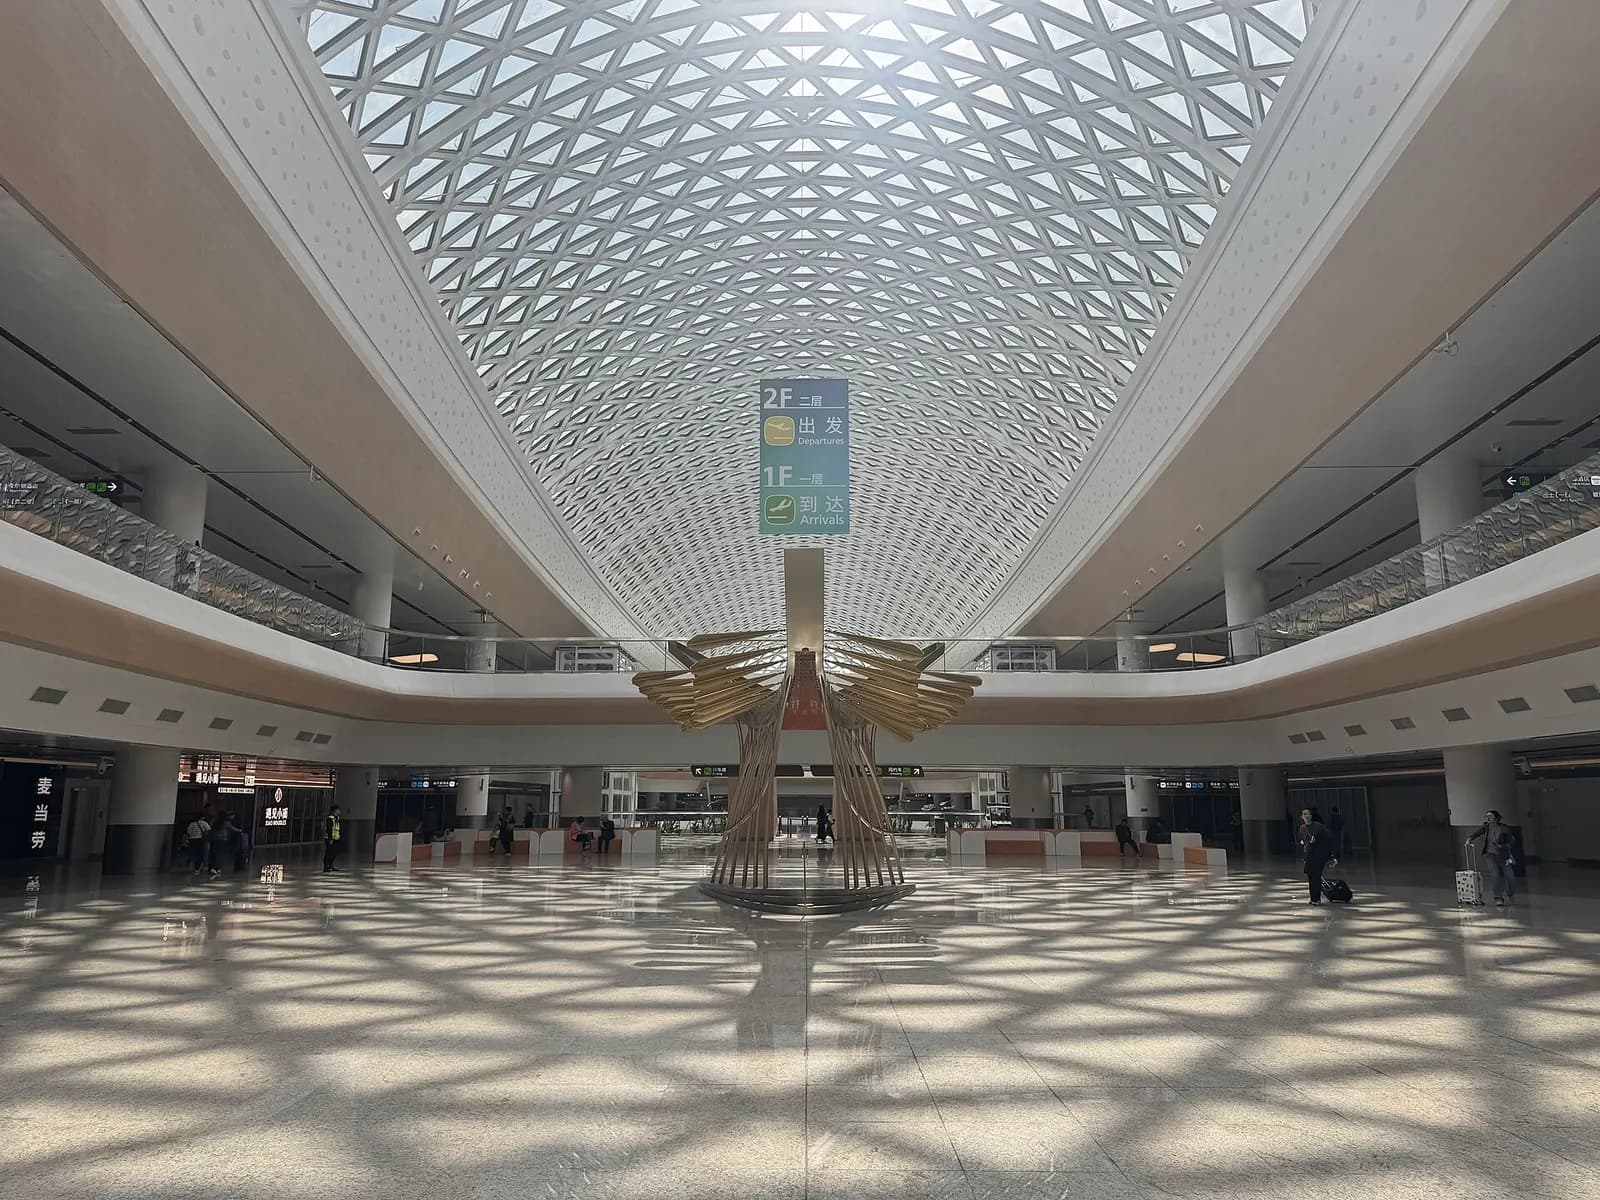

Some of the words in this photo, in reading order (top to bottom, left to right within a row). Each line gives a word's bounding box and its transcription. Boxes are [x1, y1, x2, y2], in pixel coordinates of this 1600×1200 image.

[764, 387, 793, 408] 2F
[799, 395, 823, 407] 二层
[798, 416, 844, 434] 出发
[798, 437, 844, 447] Departures
[763, 465, 793, 487] 1F
[799, 473, 824, 485] 一层
[799, 495, 844, 513] 到达
[799, 515, 845, 525] Arrivals
[31, 776, 53, 849] 麦当劳
